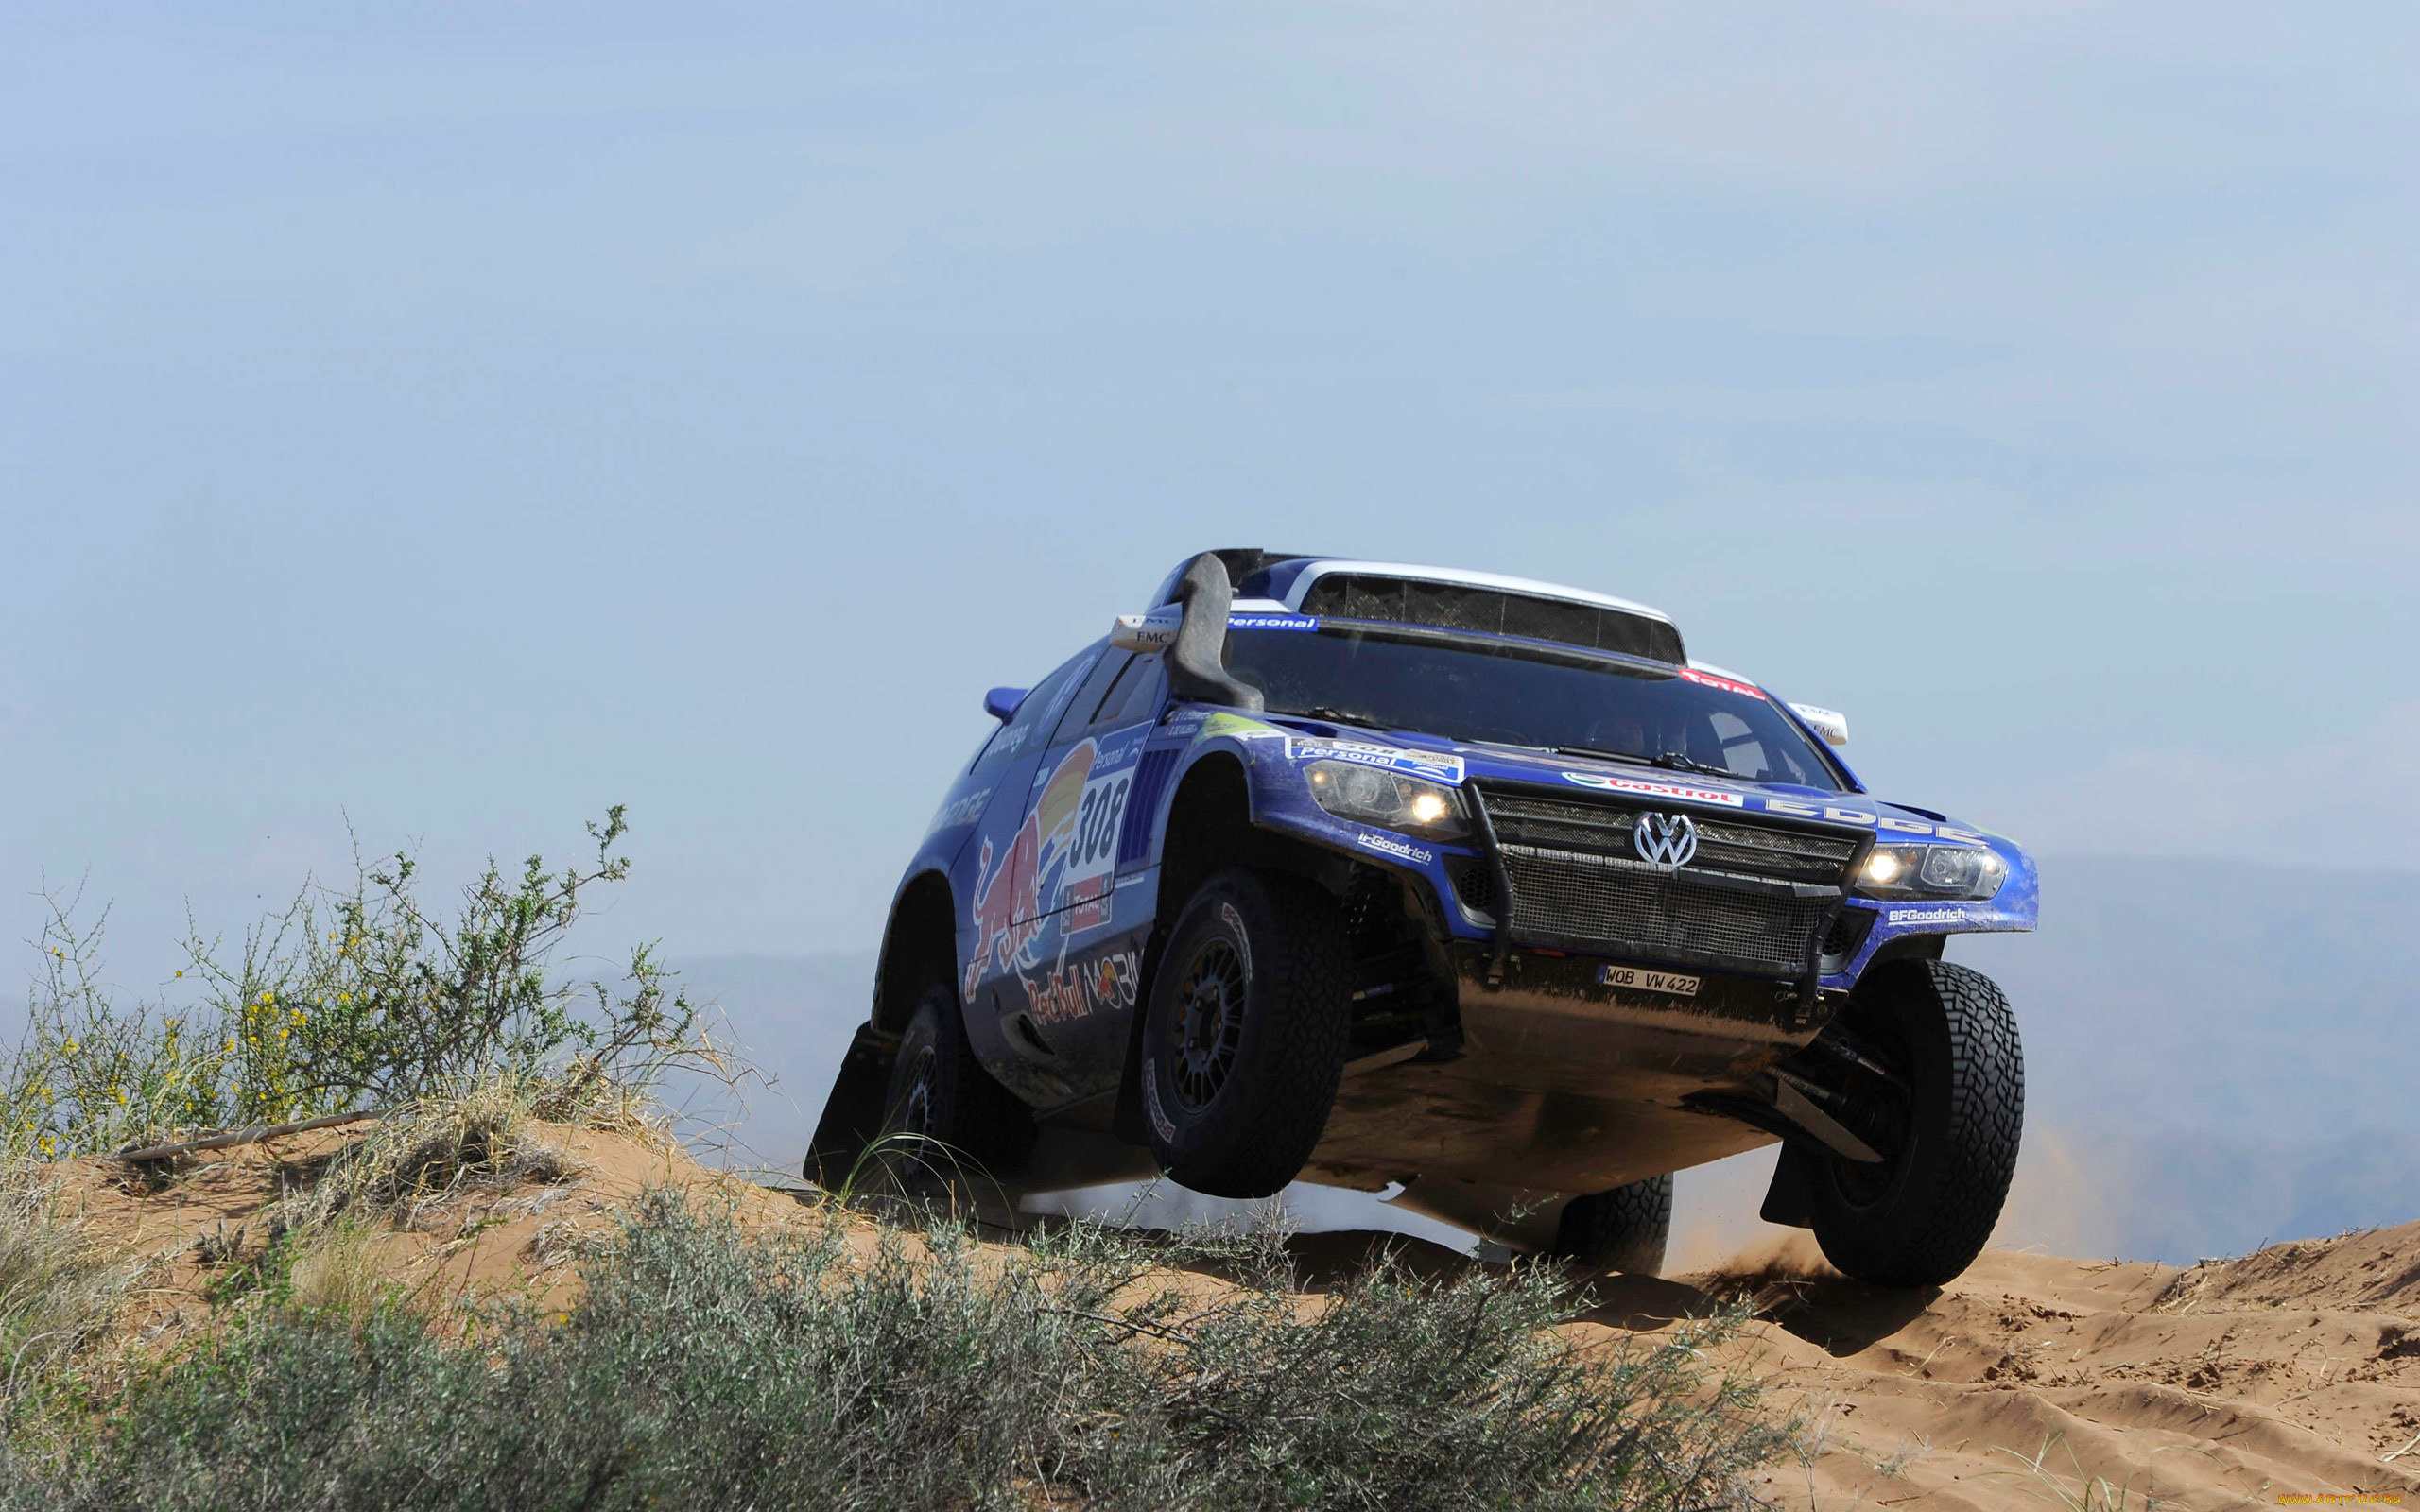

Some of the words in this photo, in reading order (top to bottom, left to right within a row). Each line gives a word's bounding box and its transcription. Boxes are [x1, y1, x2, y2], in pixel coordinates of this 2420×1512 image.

[1300, 747, 1397, 766] Personal
[1609, 778, 1734, 803] Castrol
[1069, 778, 1130, 869] 308
[1766, 799, 1991, 847] EDGE
[1889, 907, 1966, 922] BFGoodrich
[1053, 963, 1089, 1021] Bull
[1607, 968, 1635, 985] WOB
[1646, 972, 1666, 988] VW
[1667, 976, 1698, 993] 422
